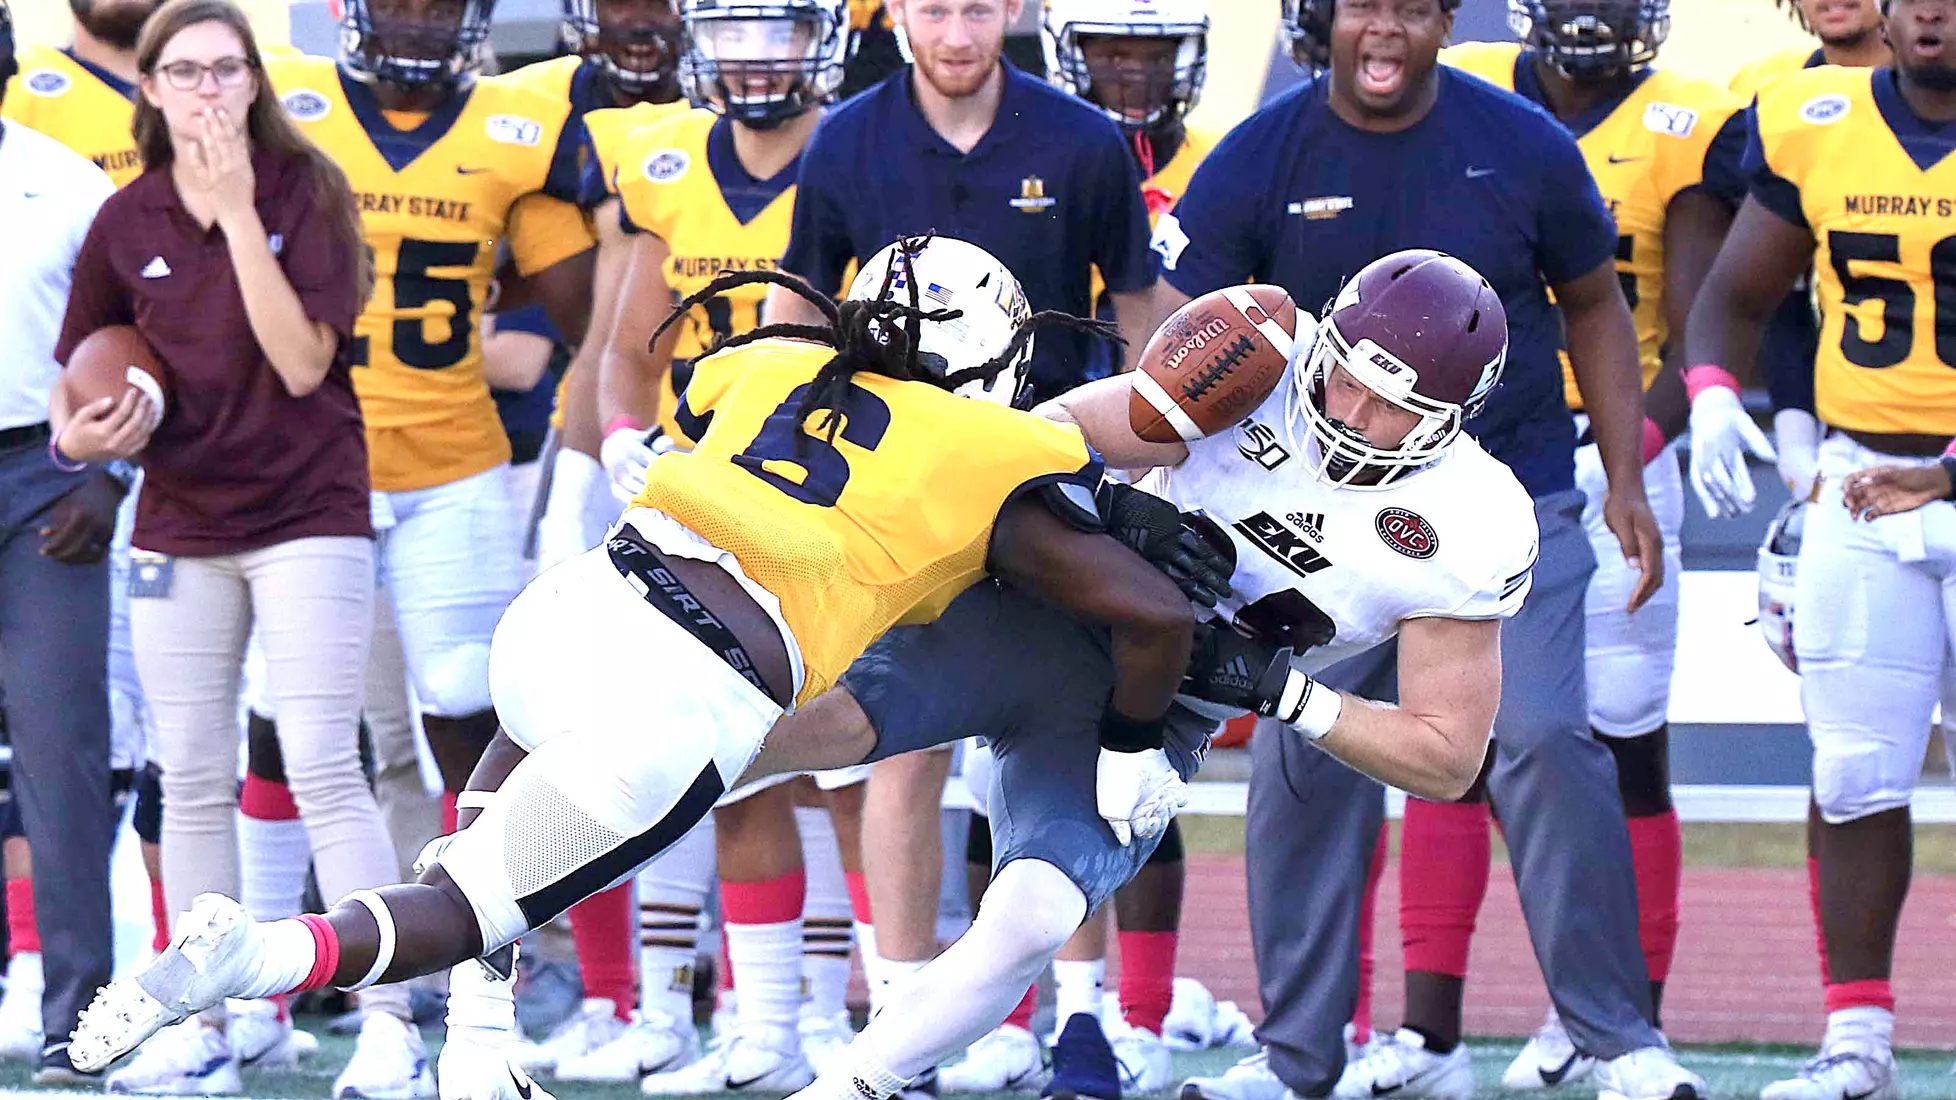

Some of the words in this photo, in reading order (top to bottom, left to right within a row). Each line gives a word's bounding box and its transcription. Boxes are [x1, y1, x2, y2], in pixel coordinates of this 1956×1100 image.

[1845, 196, 1931, 216] MURRAY
[1167, 316, 1232, 369] Wilson
[1369, 352, 1402, 375] EKU
[731, 381, 891, 507] 6
[1239, 510, 1333, 574] EKU
[1285, 512, 1325, 544] adidas
[1388, 519, 1425, 547] OVC
